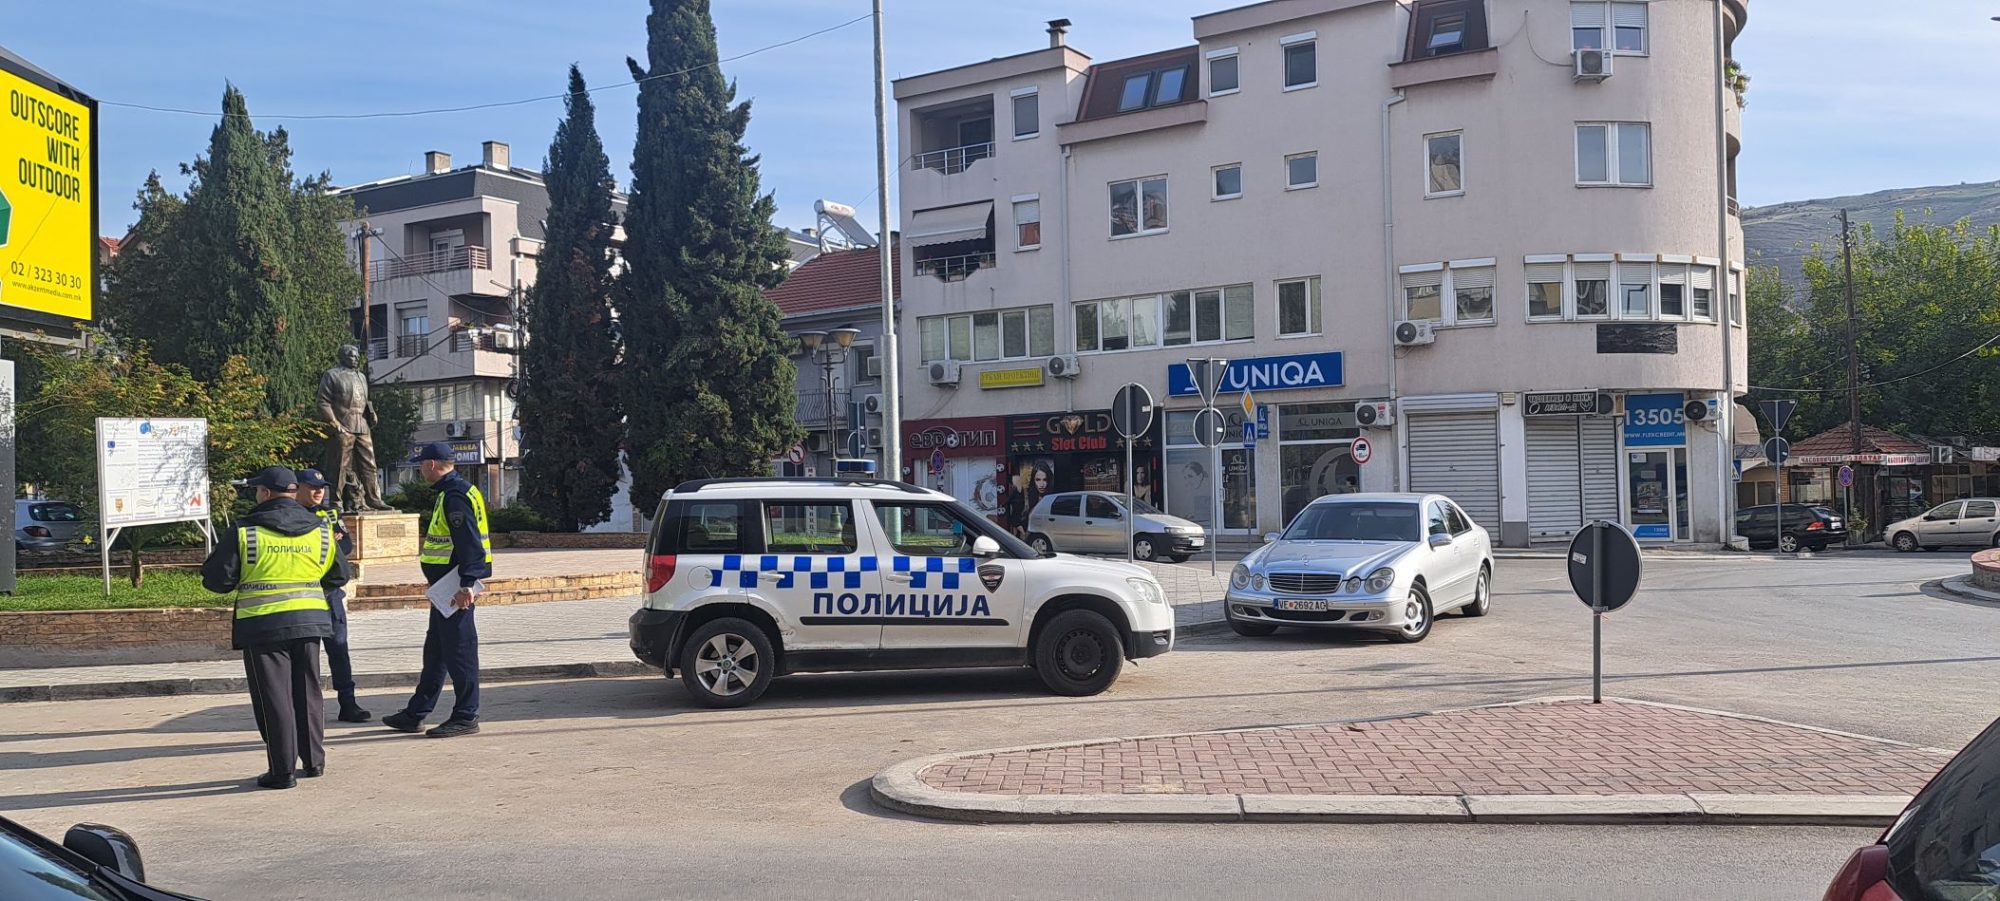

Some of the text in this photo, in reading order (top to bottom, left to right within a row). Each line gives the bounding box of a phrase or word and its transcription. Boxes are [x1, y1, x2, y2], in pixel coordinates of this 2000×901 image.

[11, 90, 79, 142] OUTSCORE
[47, 136, 79, 172] WITH
[19, 158, 80, 203] OUTDOOR
[11, 261, 24, 276] 02
[34, 267, 52, 283] 323
[55, 272, 67, 286] 30
[70, 275, 81, 289] 30
[1229, 360, 1325, 389] UNIQA
[1311, 416, 1342, 426] UNIQA
[1626, 408, 1683, 425] 13505
[1052, 436, 1106, 450] Slot Club
[267, 545, 312, 553] ПОЛИЦИЈА
[813, 593, 990, 617] ПОЛИЦИЈА
[1280, 600, 1288, 609] VE
[1294, 601, 1314, 610] 2692
